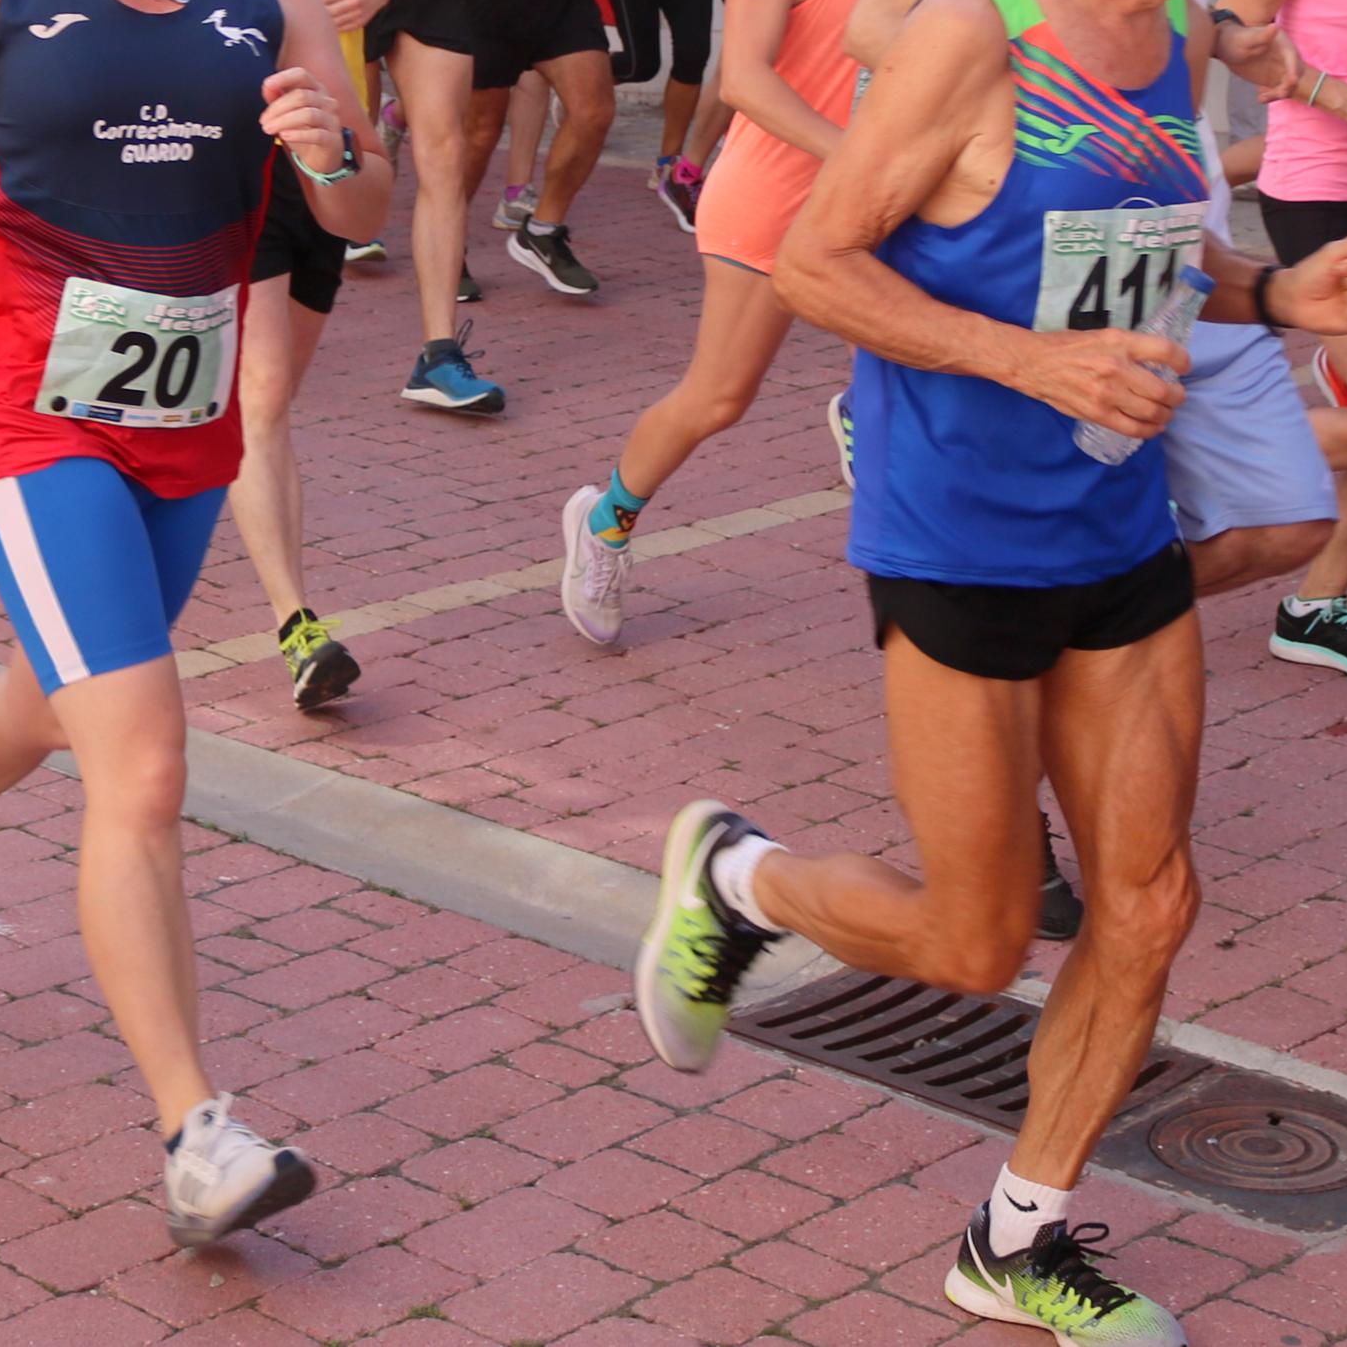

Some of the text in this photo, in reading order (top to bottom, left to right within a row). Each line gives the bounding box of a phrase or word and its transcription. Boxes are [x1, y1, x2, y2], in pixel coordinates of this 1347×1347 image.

[139, 103, 175, 123] C.D.
[93, 119, 223, 140] Correcaminos
[120, 141, 195, 164] GUARDO
[95, 331, 200, 409] 20
